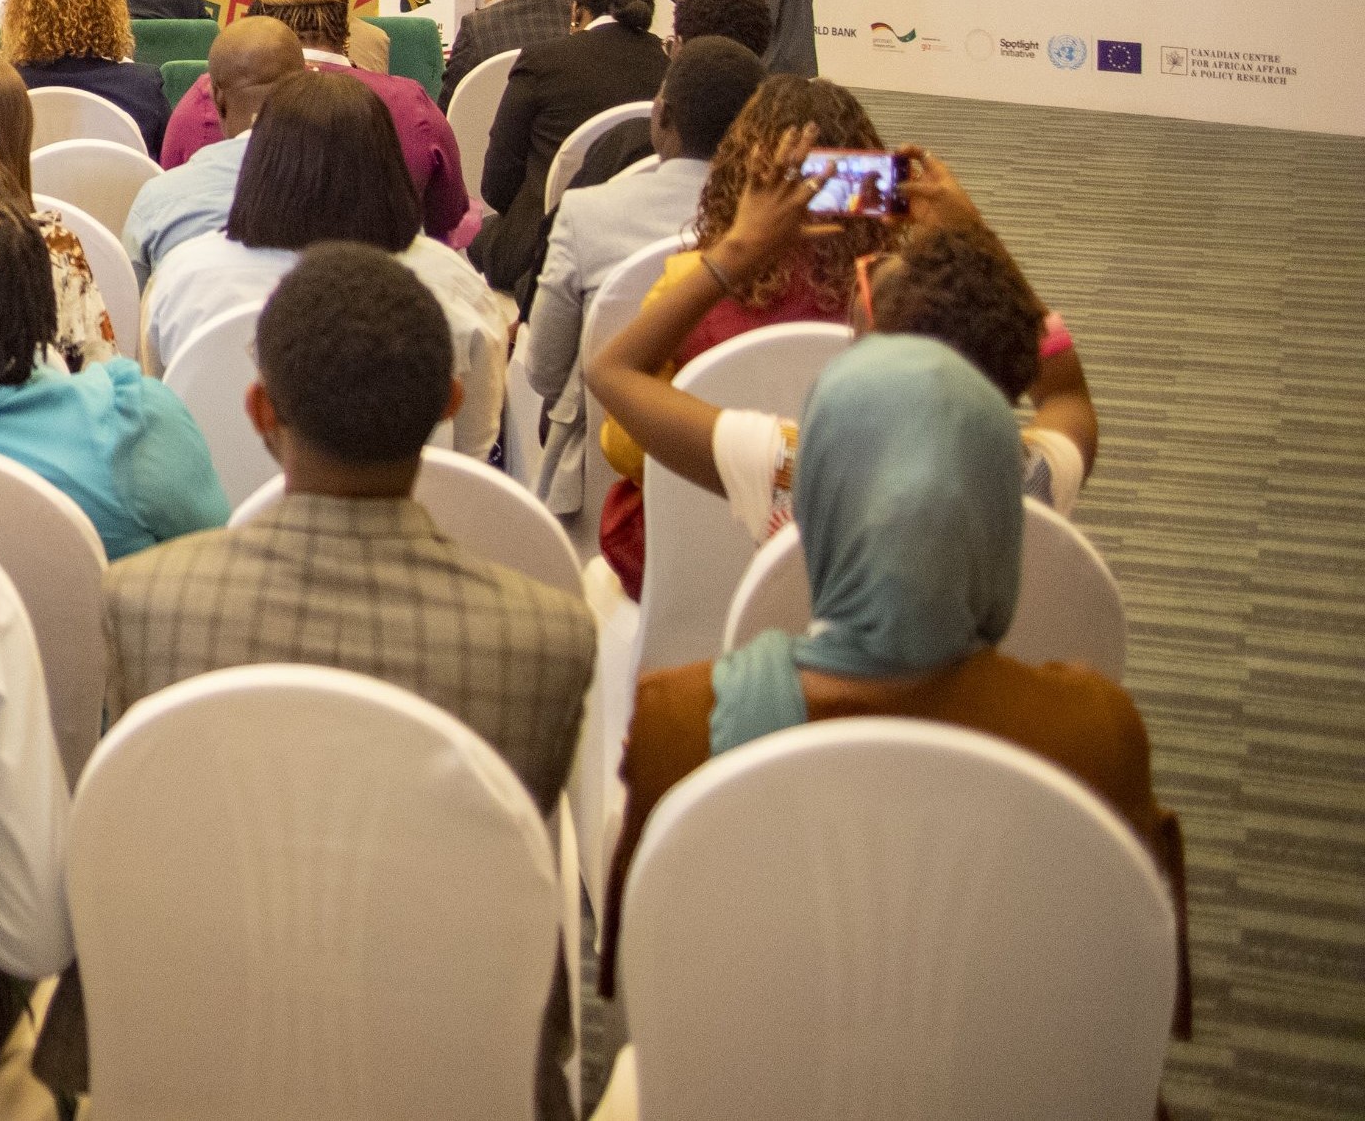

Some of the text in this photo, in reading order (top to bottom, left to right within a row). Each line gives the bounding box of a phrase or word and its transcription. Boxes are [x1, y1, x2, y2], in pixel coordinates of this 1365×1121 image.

[813, 26, 857, 38] RLD BANK
[1000, 39, 1039, 51] Spotlight
[1000, 49, 1036, 59] Initiative
[1191, 49, 1281, 64] CANADIAN CENTRE
[1191, 59, 1297, 76] FOR AFRICAN AFFAIRS
[1191, 70, 1287, 85] & POLICY RESEARCH
